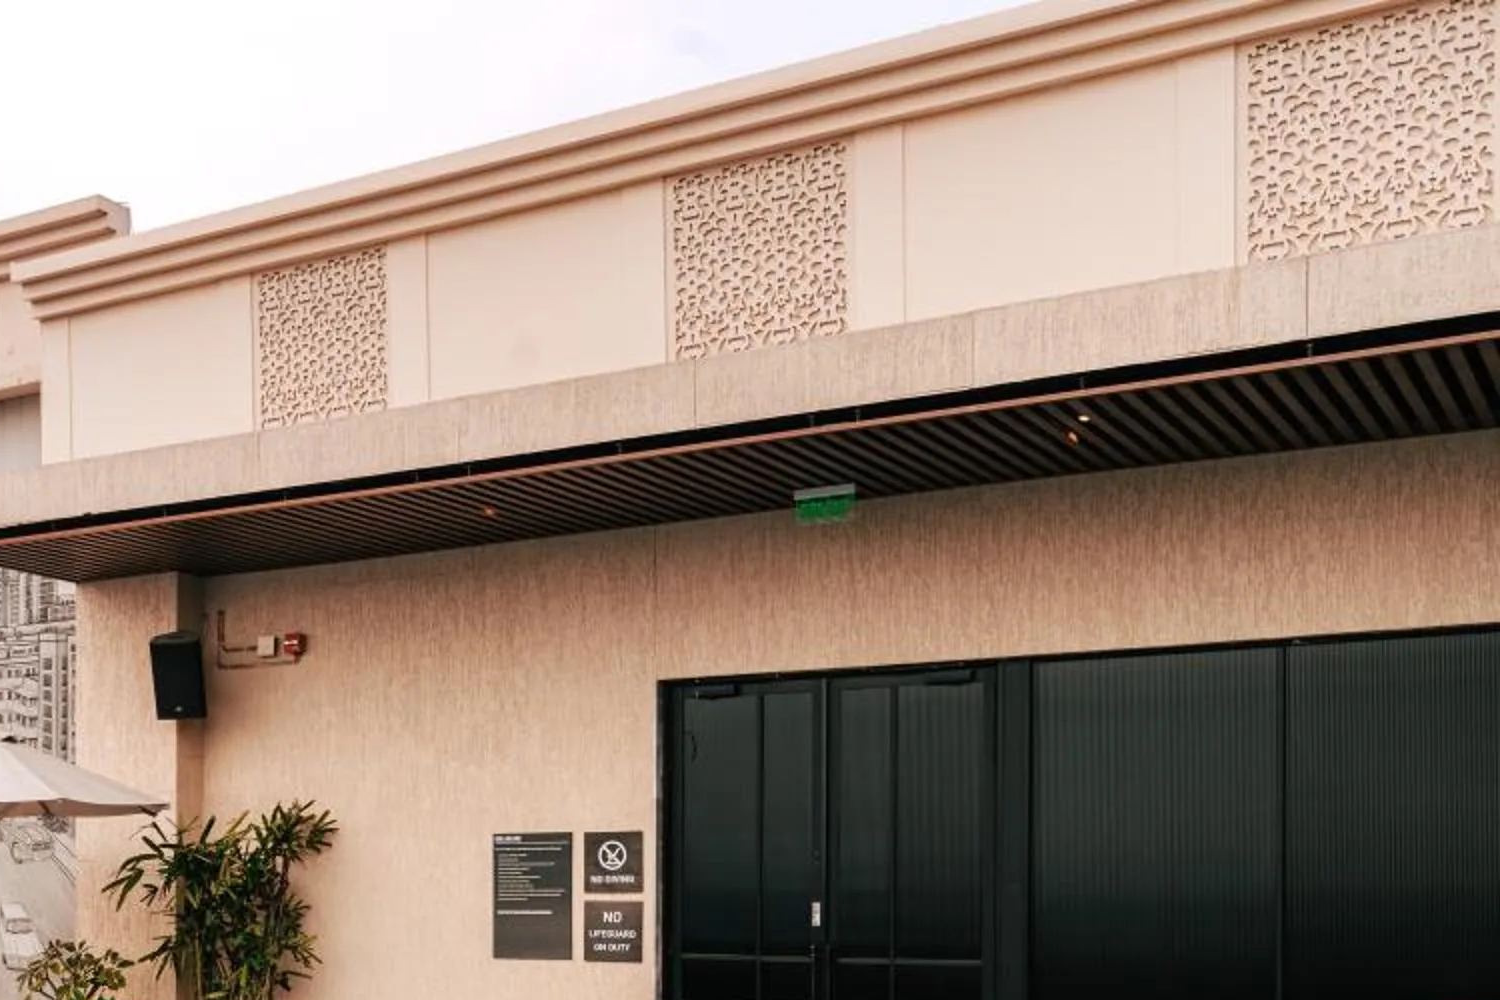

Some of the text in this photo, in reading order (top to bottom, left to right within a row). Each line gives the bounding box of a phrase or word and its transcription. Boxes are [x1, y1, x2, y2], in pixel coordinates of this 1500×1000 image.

[603, 911, 622, 923] NO
[589, 929, 637, 939] LIFEGUARD
[608, 943, 631, 951] DUTY
